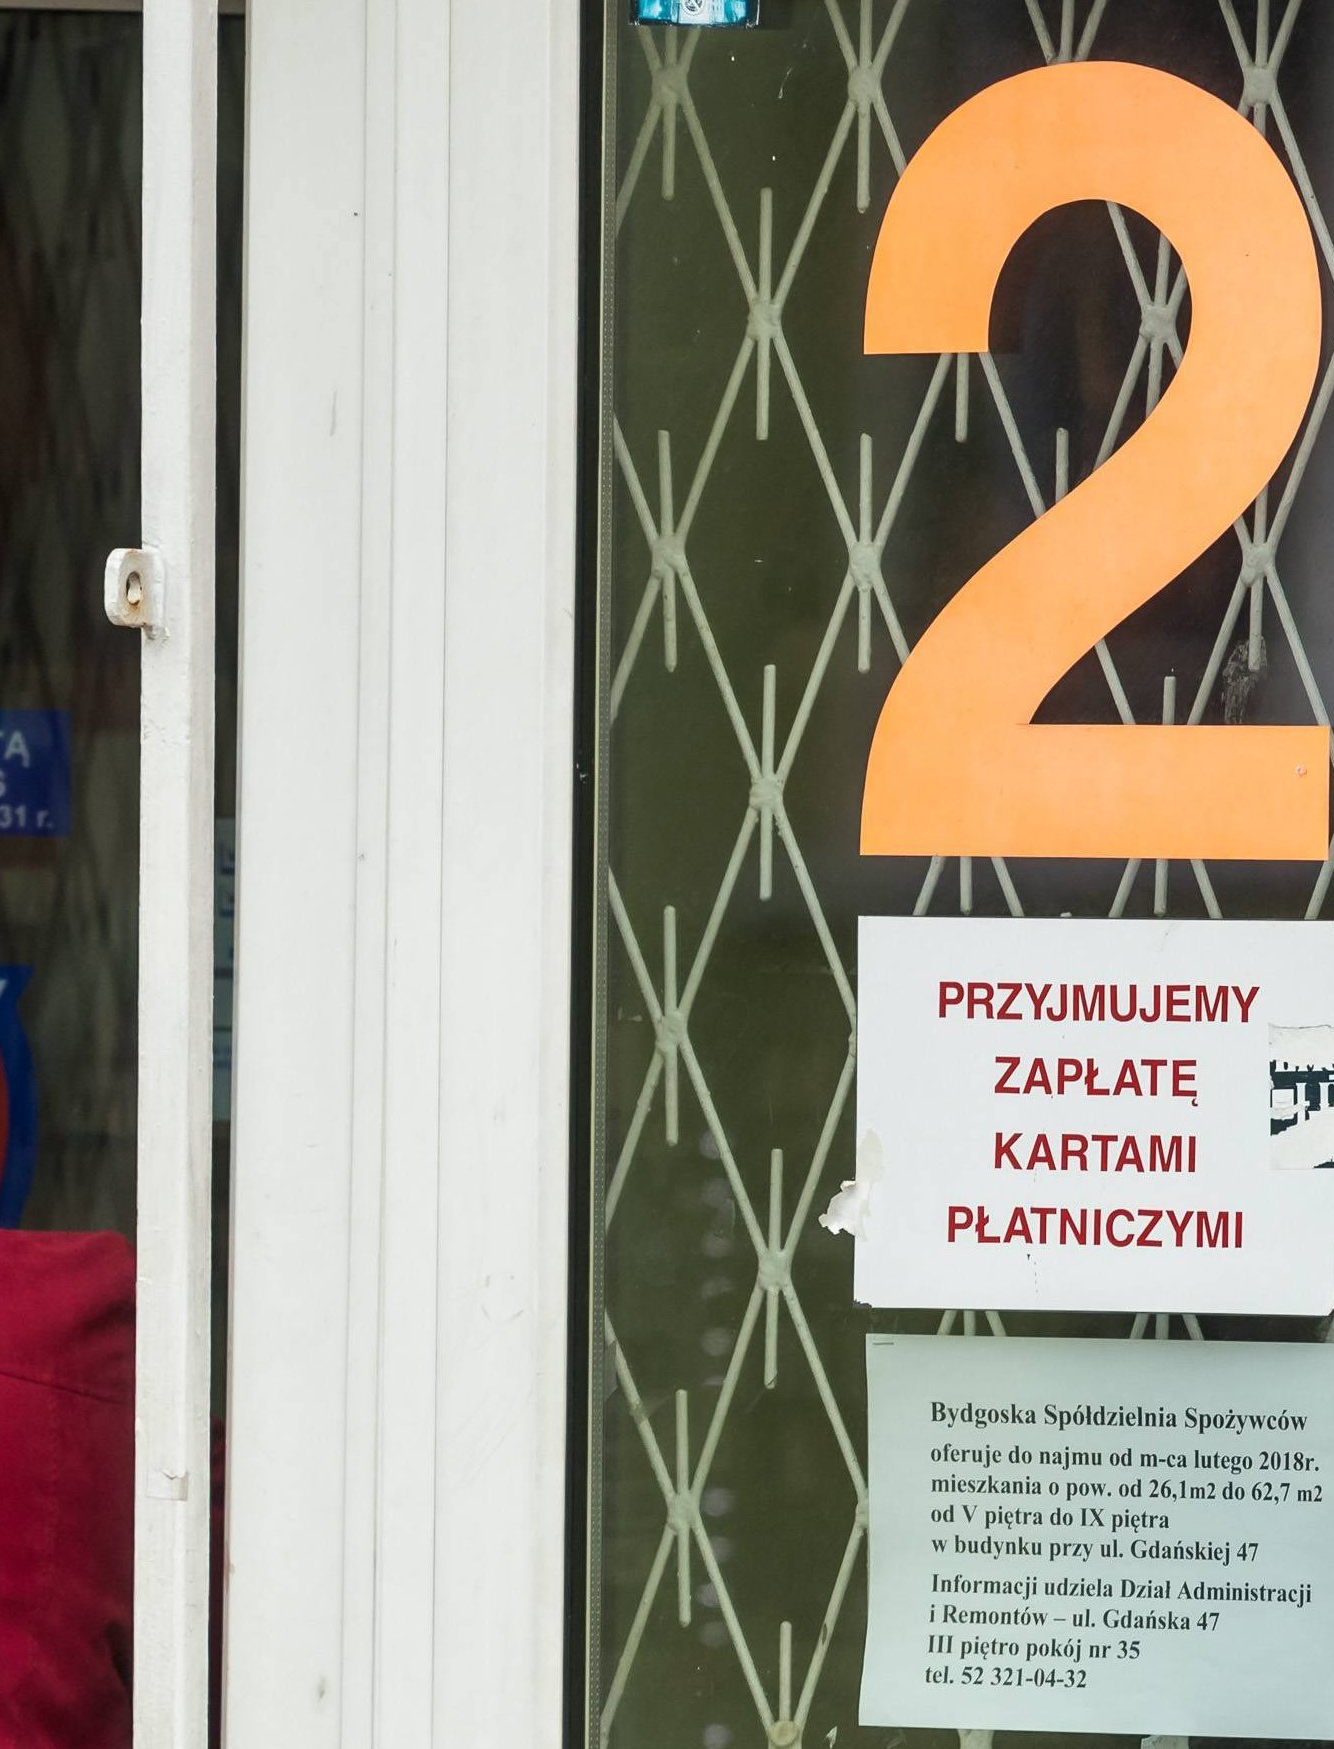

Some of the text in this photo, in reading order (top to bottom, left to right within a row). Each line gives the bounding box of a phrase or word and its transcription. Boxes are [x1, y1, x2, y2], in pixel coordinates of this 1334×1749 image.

[938, 981, 1260, 1023] PRZYJMUJEMY
[994, 1056, 1199, 1106] ZAPŁATĘ
[994, 1132, 1197, 1172] KARTAMI
[947, 1205, 1243, 1248] PŁATNICZYMI
[930, 1402, 1307, 1435] Bydgoska Spółdzielnia Spożywców
[930, 1444, 1319, 1474] oferuje do najmu od m-ca lutego 2018r.
[931, 1475, 1322, 1505] mieszkania o pow. od 26,1m2 do 62,7 m2
[931, 1505, 1169, 1534] od V piętra do IX piętra
[931, 1535, 1258, 1566] w budynku przy ul. Gdańskiej 47
[931, 1574, 1311, 1608] Informacji udziela Dział Administracji
[929, 1606, 935, 1623] i
[942, 1605, 1048, 1627] Remontów
[1072, 1609, 1096, 1627] ul.
[1102, 1609, 1191, 1630] Gdańska
[1197, 1612, 1219, 1631] 47
[927, 1634, 1140, 1662] III piętro pokój nr 35
[925, 1665, 1087, 1688] tel. 52 321-04-32
